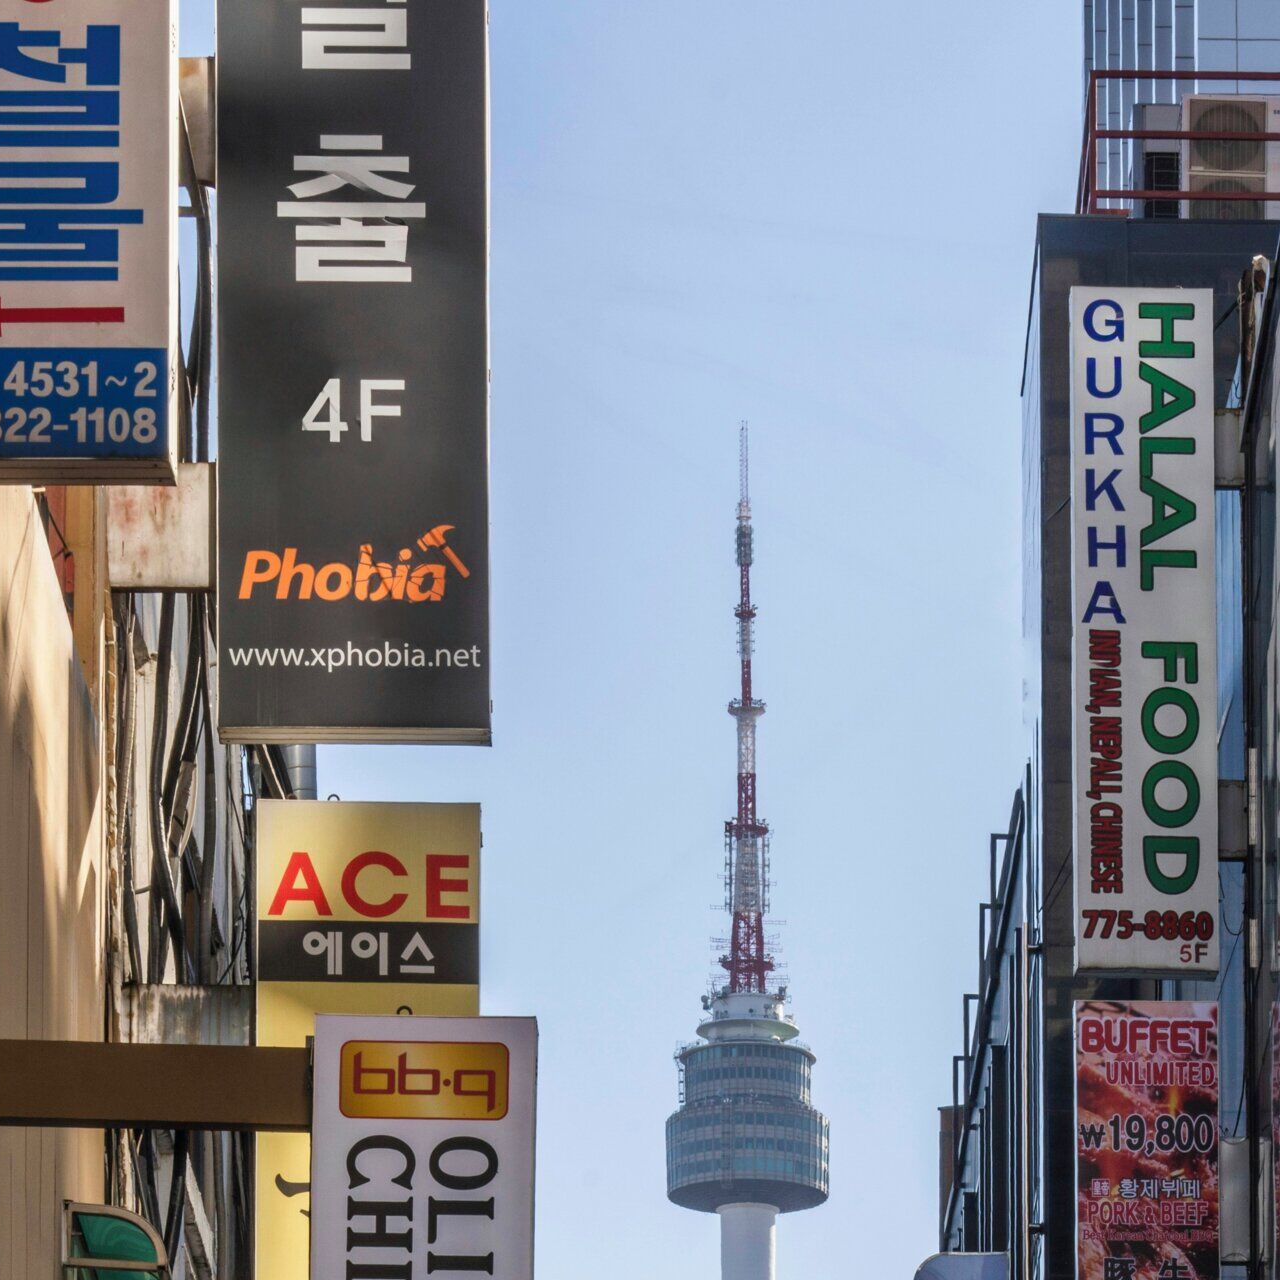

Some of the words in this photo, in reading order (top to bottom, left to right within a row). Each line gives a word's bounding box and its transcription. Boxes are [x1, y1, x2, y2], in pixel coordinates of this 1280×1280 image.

[301, 377, 406, 443] 4F
[1082, 299, 1127, 624] GURKHA
[1139, 302, 1197, 592] HALAL
[238, 543, 448, 604] Phobia
[228, 641, 482, 675] www.xphobia.net
[1140, 641, 1201, 896] FOOD
[1090, 801, 1123, 894] CHINESE
[267, 851, 470, 919] ACE
[1082, 909, 1214, 941] 775-8860
[302, 931, 436, 976] 에이스
[1179, 943, 1209, 964] 5F
[1081, 1019, 1214, 1054] BUFFET
[1106, 1062, 1215, 1086] UNLIMITED
[1120, 1178, 1201, 1198] 황제뷔페
[1087, 1201, 1140, 1225] PORK
[1144, 1205, 1156, 1225] &
[1160, 1201, 1208, 1225] BEEF
